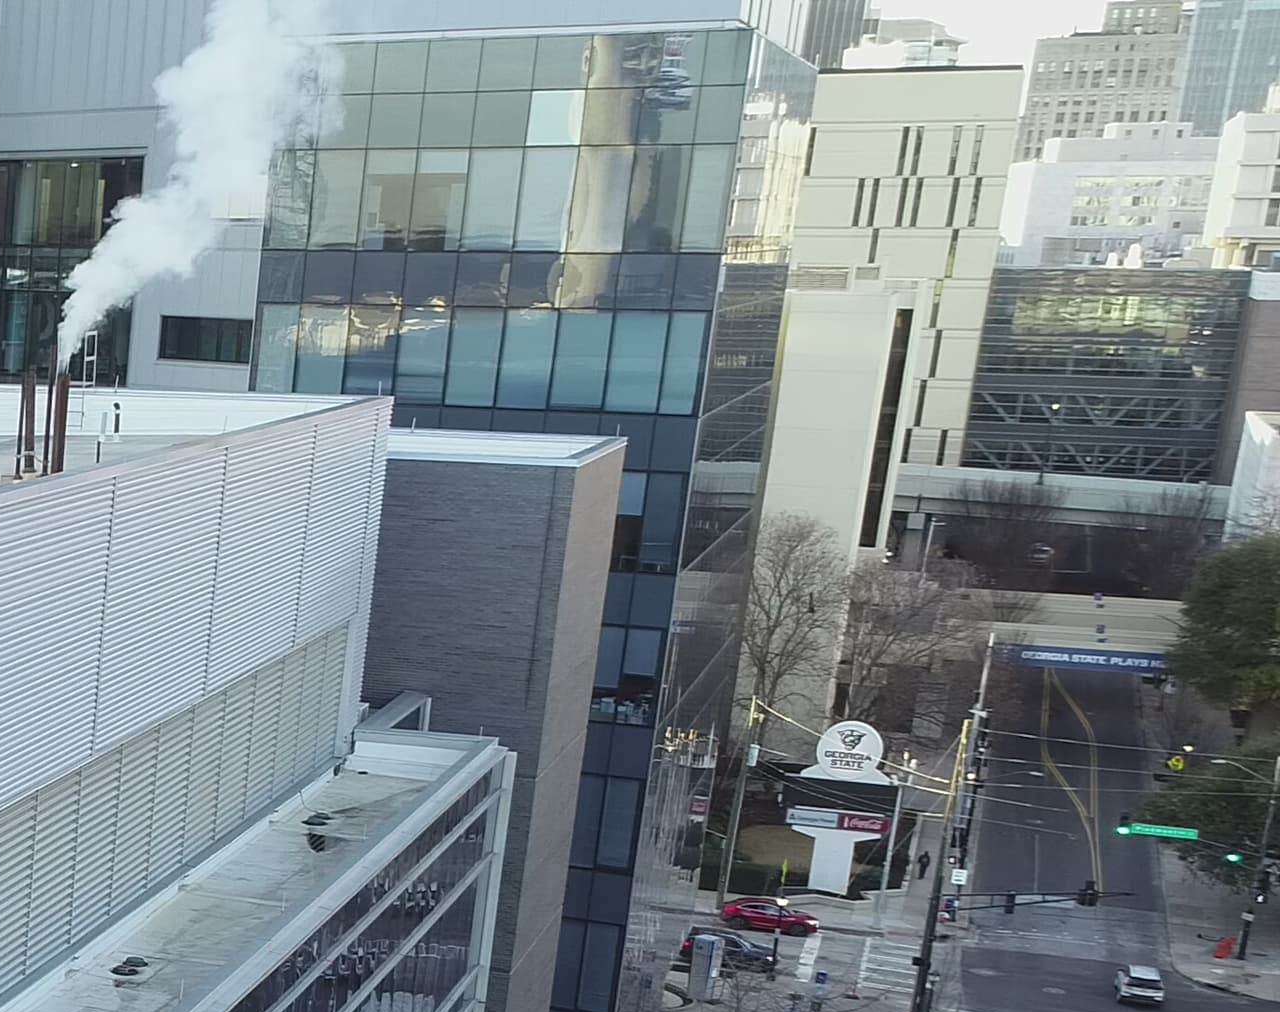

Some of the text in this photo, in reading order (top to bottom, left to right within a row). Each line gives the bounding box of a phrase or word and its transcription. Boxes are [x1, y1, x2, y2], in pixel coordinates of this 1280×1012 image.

[1021, 651, 1069, 662] GEORGIA
[1071, 653, 1106, 665] STATE
[1110, 656, 1148, 667] PLAYS
[824, 750, 873, 762] GEORGIA
[830, 759, 865, 769] STATE
